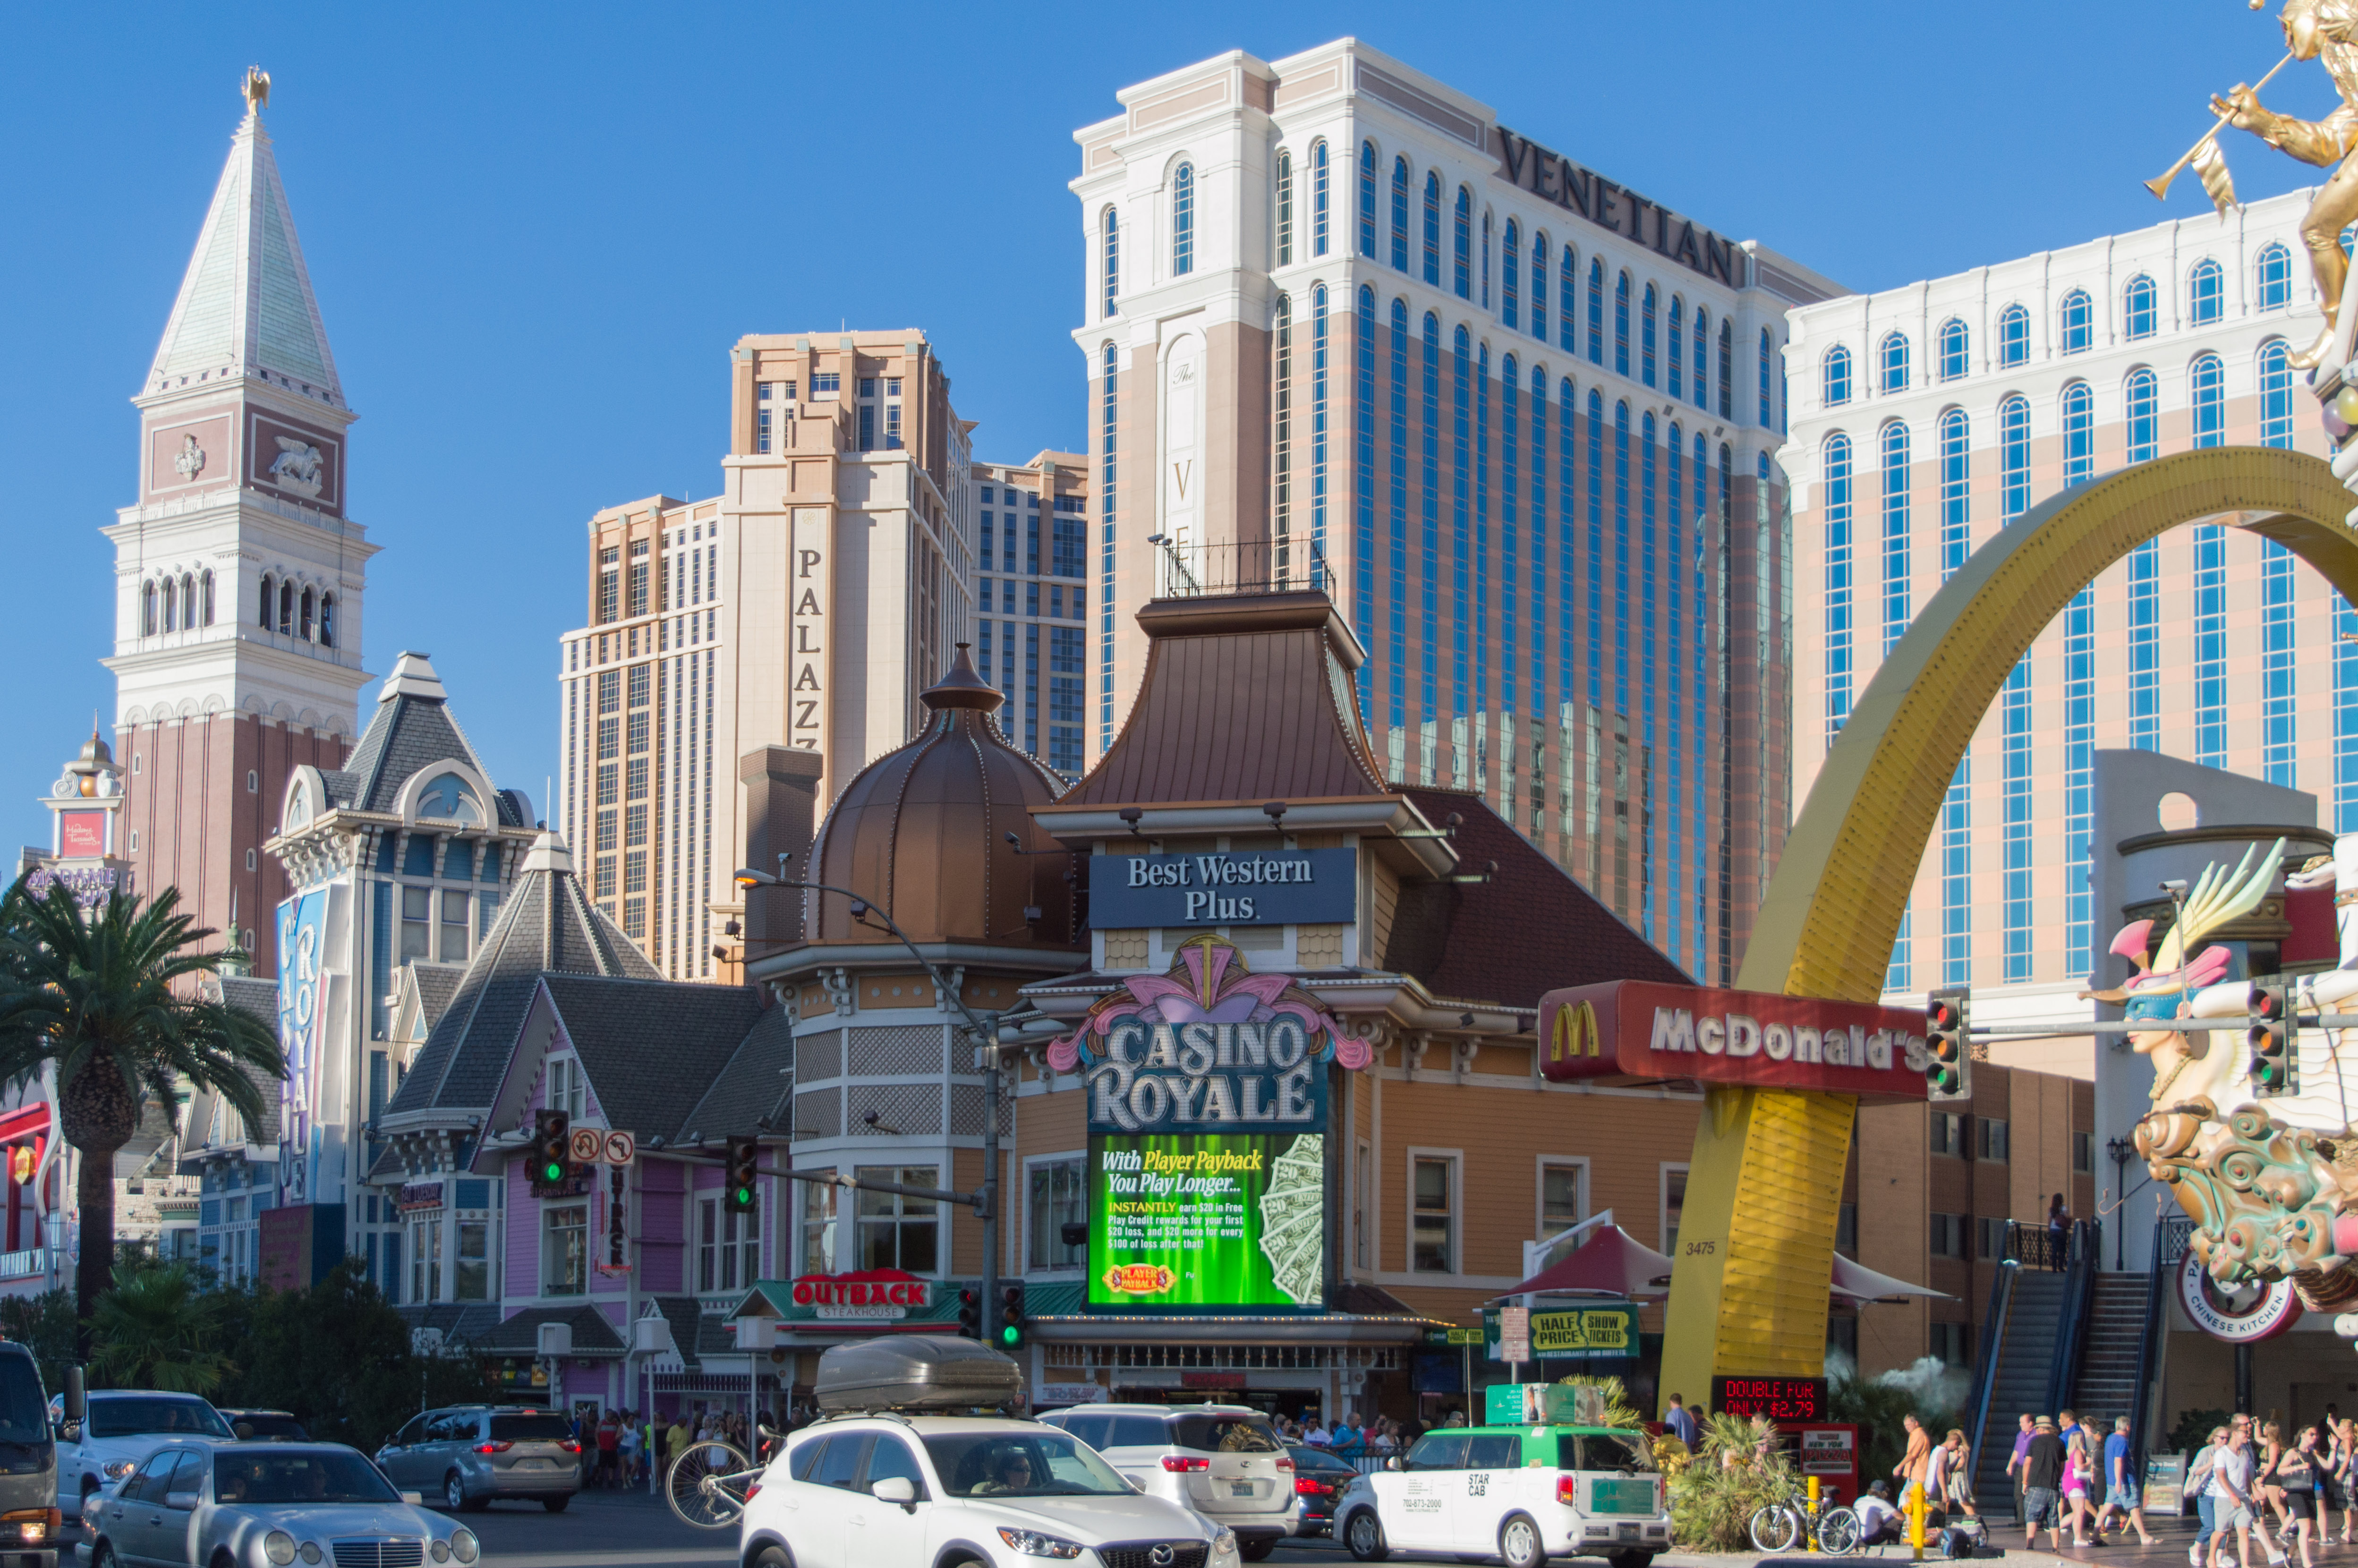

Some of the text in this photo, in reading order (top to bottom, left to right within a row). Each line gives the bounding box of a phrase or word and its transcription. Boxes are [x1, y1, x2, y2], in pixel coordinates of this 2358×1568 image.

[1498, 126, 1735, 286] VENETIAN
[1173, 363, 1194, 384] The
[793, 550, 823, 801] PALAZ
[66, 824, 93, 833] Madame
[27, 867, 116, 888] MADAME
[1127, 854, 1312, 886] Best Western
[1107, 1017, 1306, 1076] CASINO
[1650, 1006, 1929, 1073] McDonald's
[1088, 1056, 1315, 1130] ROYALE
[1102, 1149, 1263, 1175] With Player Payback
[1108, 1172, 1241, 1197] You Play Longer...
[1109, 1202, 1176, 1212] INSTANTLY
[1199, 1202, 1213, 1213] $20
[1215, 1203, 1223, 1212] in
[1226, 1203, 1243, 1212] Free
[1108, 1215, 1243, 1227] Play Credit rewards for your first
[1108, 1227, 1123, 1236] $20
[1125, 1227, 1145, 1237] loss,
[1147, 1227, 1162, 1236] and
[1165, 1227, 1179, 1236] $20
[1206, 1227, 1218, 1236] for
[1220, 1229, 1243, 1238] every
[1108, 1239, 1204, 1249] $100 of loss after that!
[1686, 1241, 1715, 1255] 3475
[1121, 1269, 1157, 1278] PLAYER
[1122, 1279, 1157, 1288] PAYBACK
[793, 1282, 924, 1305] OUTBACK
[824, 1307, 897, 1317] STEAKHOUSE
[2191, 1295, 2283, 1332] CHINESE KITCHEN
[1541, 1316, 1575, 1330] HALF
[1588, 1315, 1618, 1329] SHOW
[1540, 1329, 1621, 1345] PRICE TICKETS
[1727, 1381, 1814, 1398] DOUBLE FOR
[1727, 1400, 1814, 1417] ONLY $2.79
[1805, 1449, 1850, 1462] PIZZA
[1468, 1474, 1490, 1484] STAR
[1468, 1485, 1486, 1496] CAB
[1403, 1499, 1442, 1508] 702-873-2000
